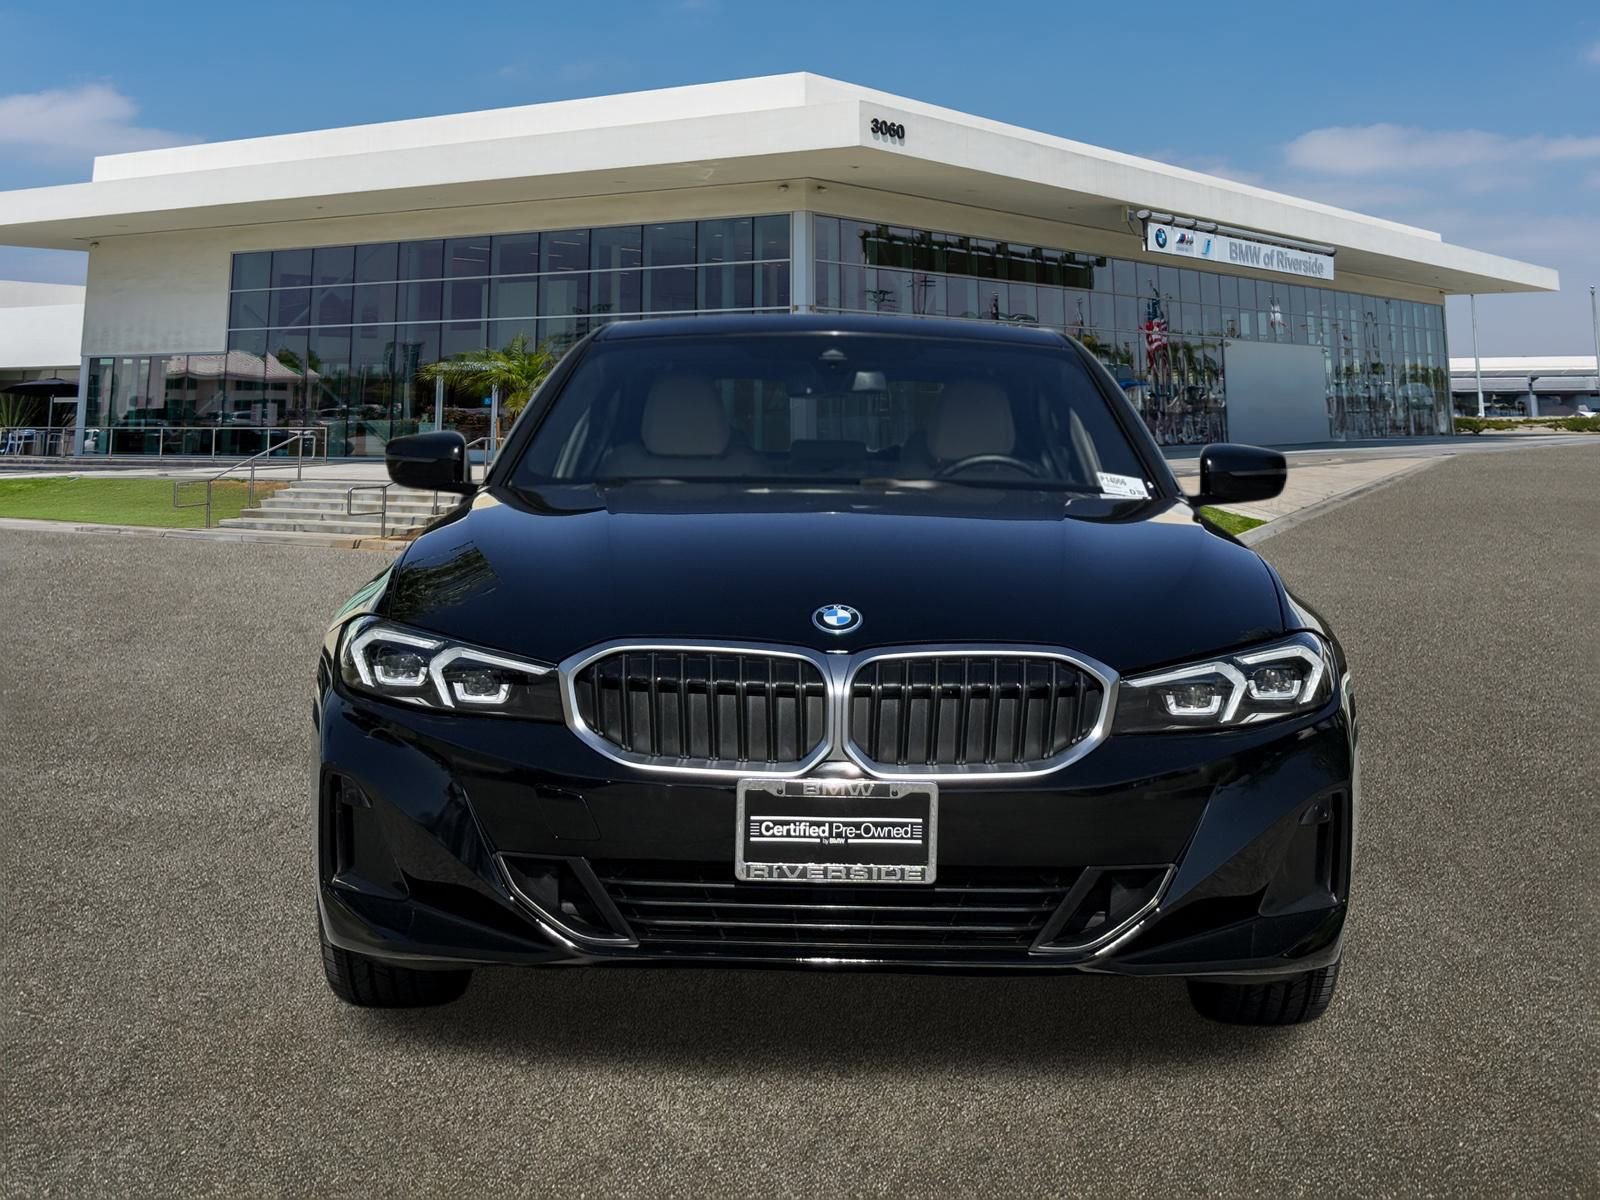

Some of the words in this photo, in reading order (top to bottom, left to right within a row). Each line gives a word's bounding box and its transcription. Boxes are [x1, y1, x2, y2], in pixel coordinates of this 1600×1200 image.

[871, 118, 905, 139] 3060
[1229, 241, 1261, 265] BMW
[1263, 249, 1276, 268] of
[1276, 250, 1325, 275] Riverside
[802, 780, 875, 796] BMW
[760, 821, 829, 837] Certified
[832, 822, 911, 838] Pre-Owned
[749, 864, 926, 880] RIVERSIDE
